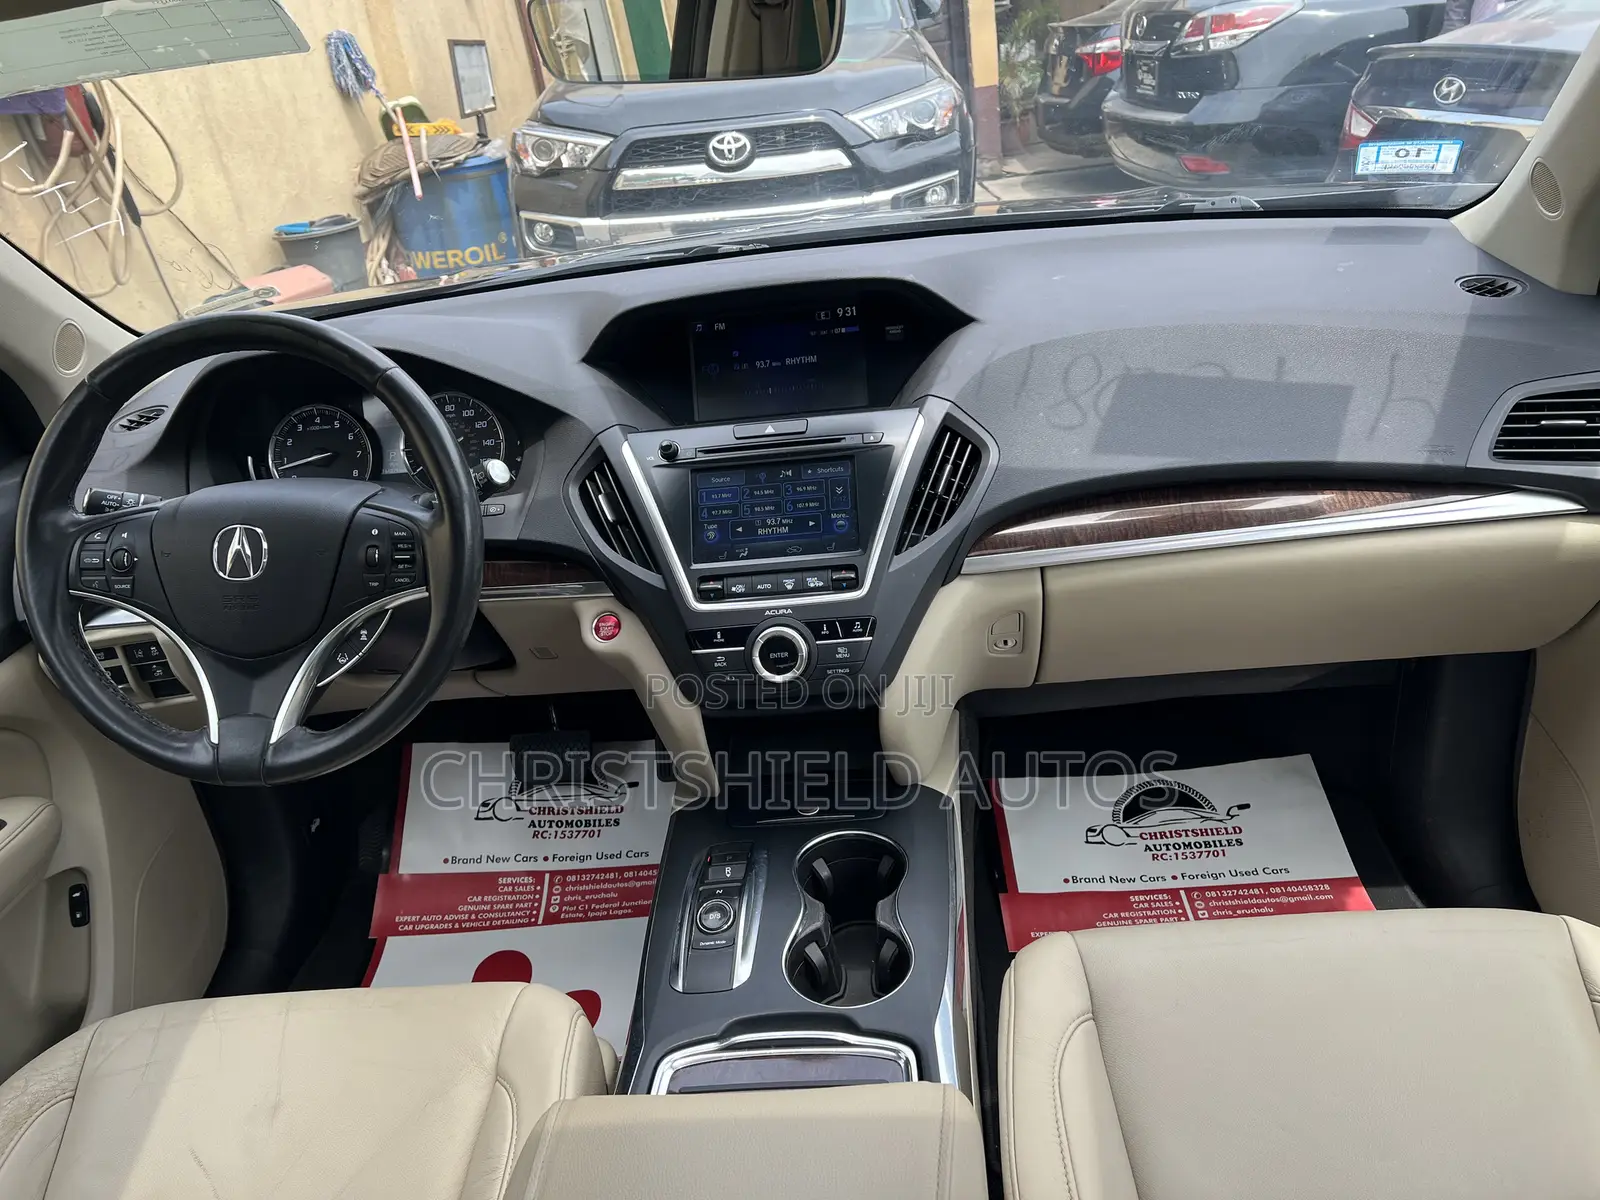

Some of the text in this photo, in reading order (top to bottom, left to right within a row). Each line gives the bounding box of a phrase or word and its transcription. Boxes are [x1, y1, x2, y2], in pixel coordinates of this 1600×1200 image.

[411, 242, 506, 269] WEROIL
[714, 323, 726, 331] FM
[755, 359, 770, 369] 93.7
[785, 355, 818, 366] RHYTHM
[286, 438, 292, 446] 2
[817, 466, 844, 474] Shortcuts
[743, 488, 750, 499] 2
[785, 484, 793, 495] 3
[743, 505, 750, 515] 5
[786, 501, 794, 512] 6
[701, 508, 708, 519] 4
[758, 526, 789, 535] RHYTHM
[764, 608, 793, 616] ACURA
[528, 804, 624, 816] CHRISTSHIELD
[528, 818, 620, 829] AUTOMOBILES
[532, 829, 601, 840] RC:1537701
[1139, 825, 1243, 841] CHRISTSHIELD
[1144, 837, 1244, 853] AUTOMOBILES
[451, 849, 650, 865] Brand New Cars Foreign Used Cars
[1152, 849, 1227, 862] RC:1537701
[624, 869, 659, 878] 0814045
[725, 866, 732, 874] R
[1071, 866, 1290, 884] Brand New Cars Foreign Used Cars
[498, 876, 536, 884] SERVICES:
[1270, 884, 1331, 894] 08140458328
[483, 894, 534, 902] REGISTRATION
[1129, 893, 1171, 902] SERVICES:
[1208, 893, 1334, 907] christshieldautos@gmail.com
[591, 901, 620, 909] Federal
[621, 899, 653, 907] Junction
[478, 910, 531, 919] CONSULTANCY
[1120, 909, 1177, 918] REGISTRATION
[1212, 906, 1274, 917] chris_eruchalu
[414, 922, 452, 931] UPGRADES
[461, 920, 490, 928] VEHICLE
[492, 918, 529, 926] DETAILING
